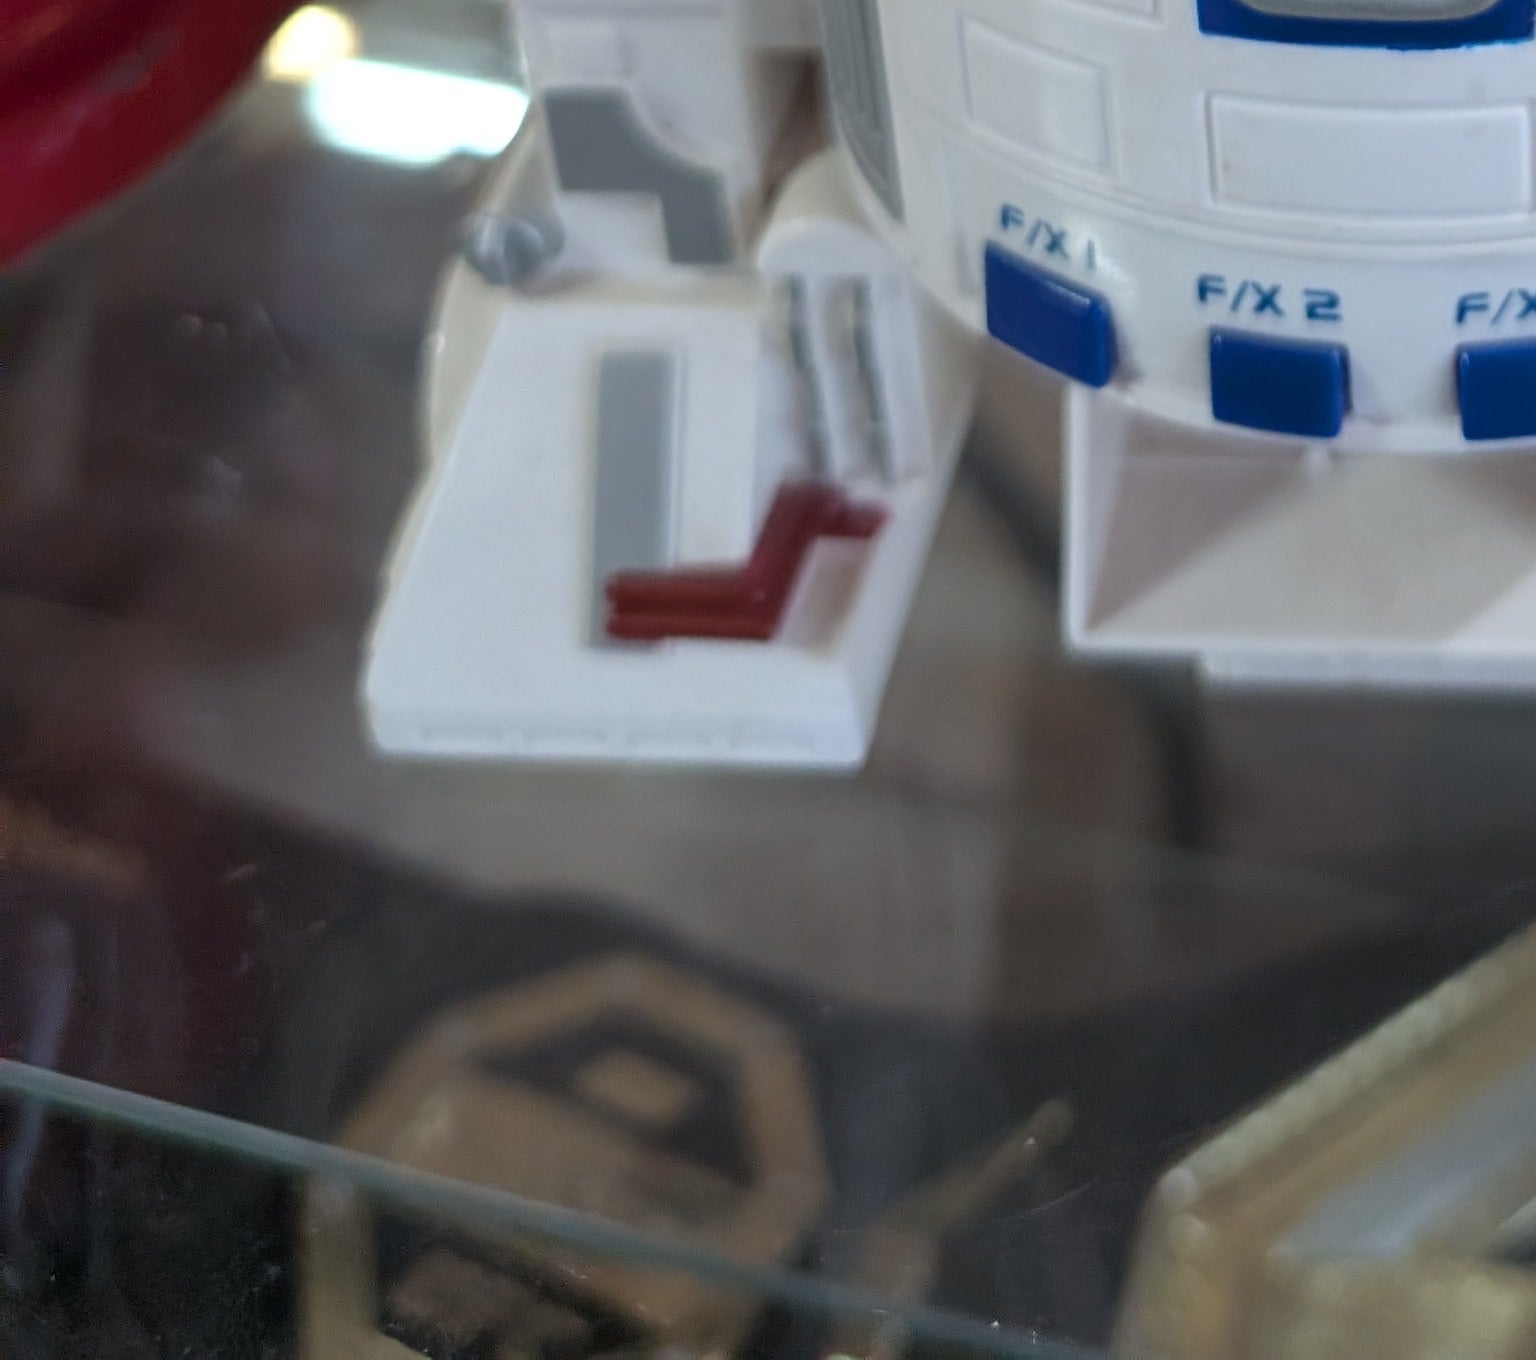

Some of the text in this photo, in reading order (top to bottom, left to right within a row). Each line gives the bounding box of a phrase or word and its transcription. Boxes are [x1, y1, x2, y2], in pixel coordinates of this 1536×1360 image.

[1000, 203, 1097, 271] F/X 1
[1196, 274, 1343, 322] F/X 2
